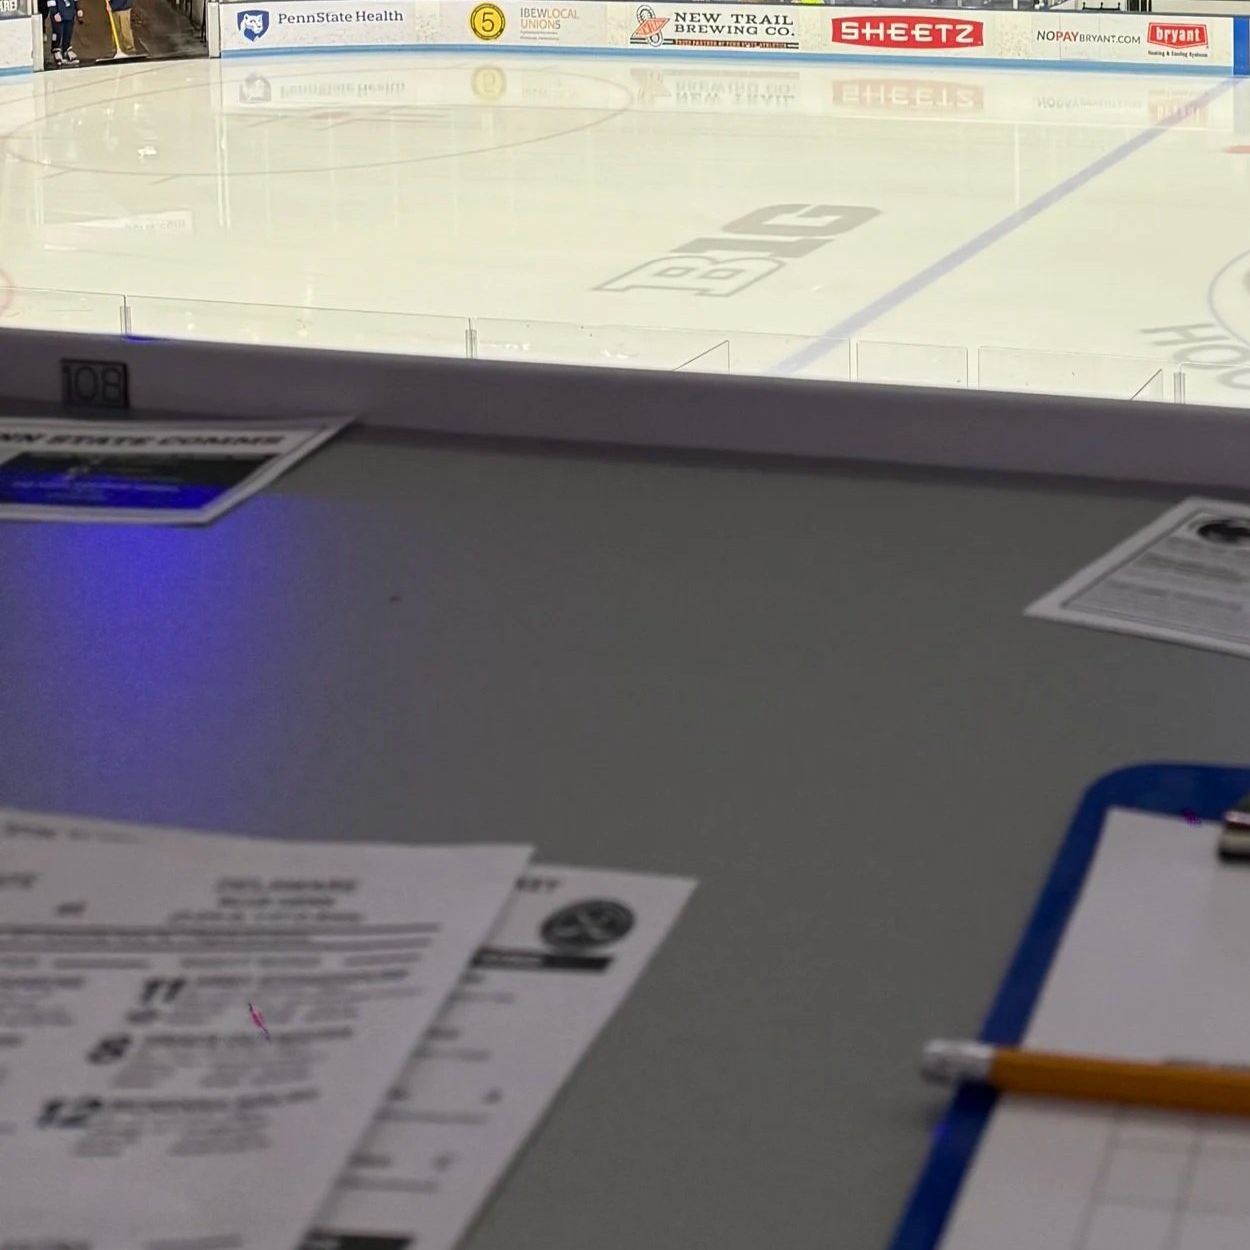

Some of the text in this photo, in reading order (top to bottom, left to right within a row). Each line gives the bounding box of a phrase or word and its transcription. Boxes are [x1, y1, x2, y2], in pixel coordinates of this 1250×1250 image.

[278, 10, 403, 24] PennState Health
[481, 12, 494, 33] 5
[674, 12, 794, 26] NEW TRAIL
[675, 24, 795, 36] BREWING CO.
[841, 21, 976, 44] SHEETZ
[1155, 26, 1200, 44] bryant
[63, 365, 122, 402] 108
